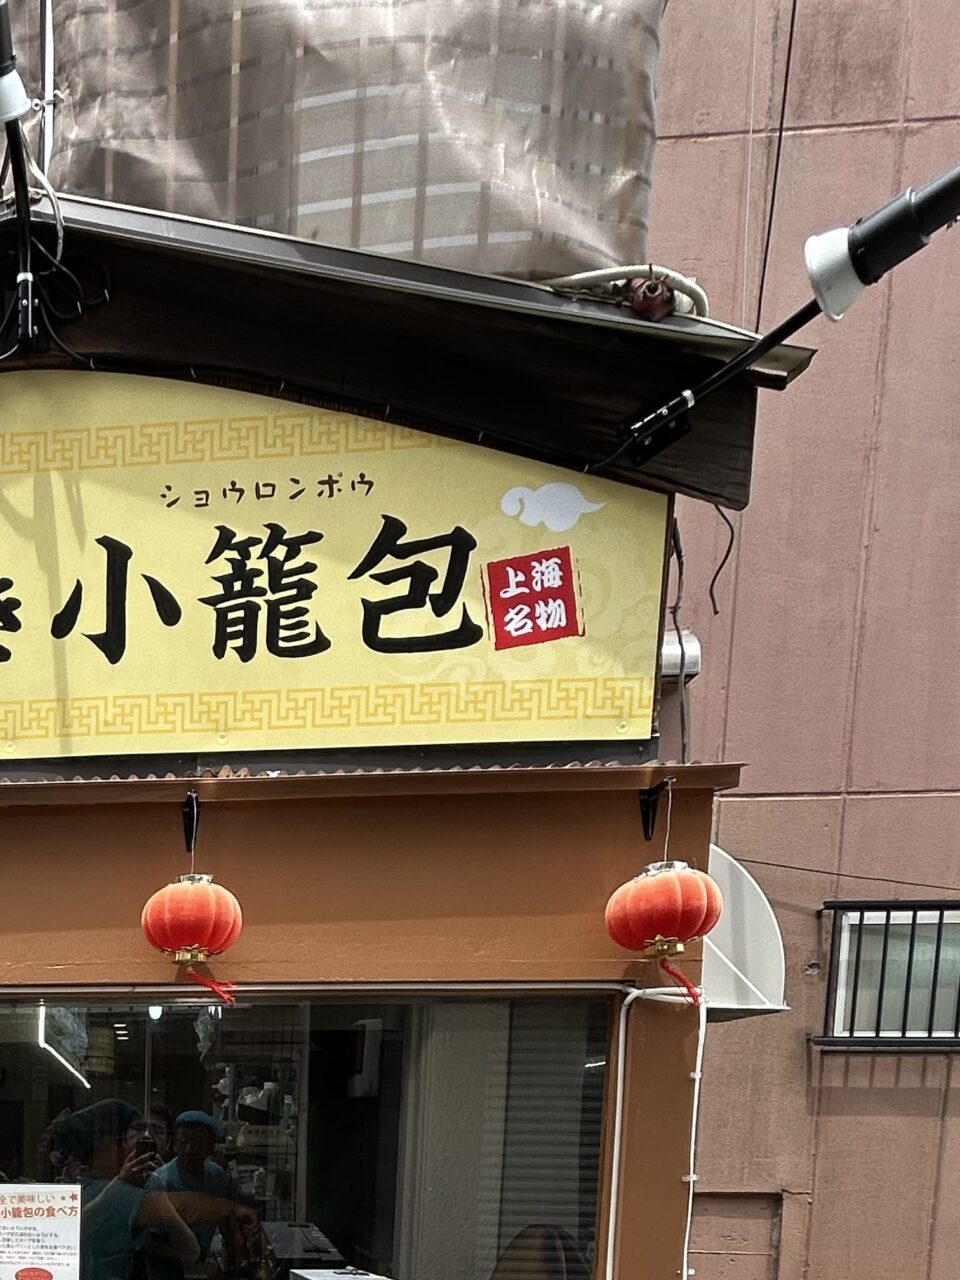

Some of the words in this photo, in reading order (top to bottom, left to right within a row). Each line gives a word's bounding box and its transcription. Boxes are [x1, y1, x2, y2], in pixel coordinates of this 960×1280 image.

[160, 472, 375, 508] ショウロンポウ
[499, 557, 564, 599] 上海
[503, 598, 567, 637] 名物
